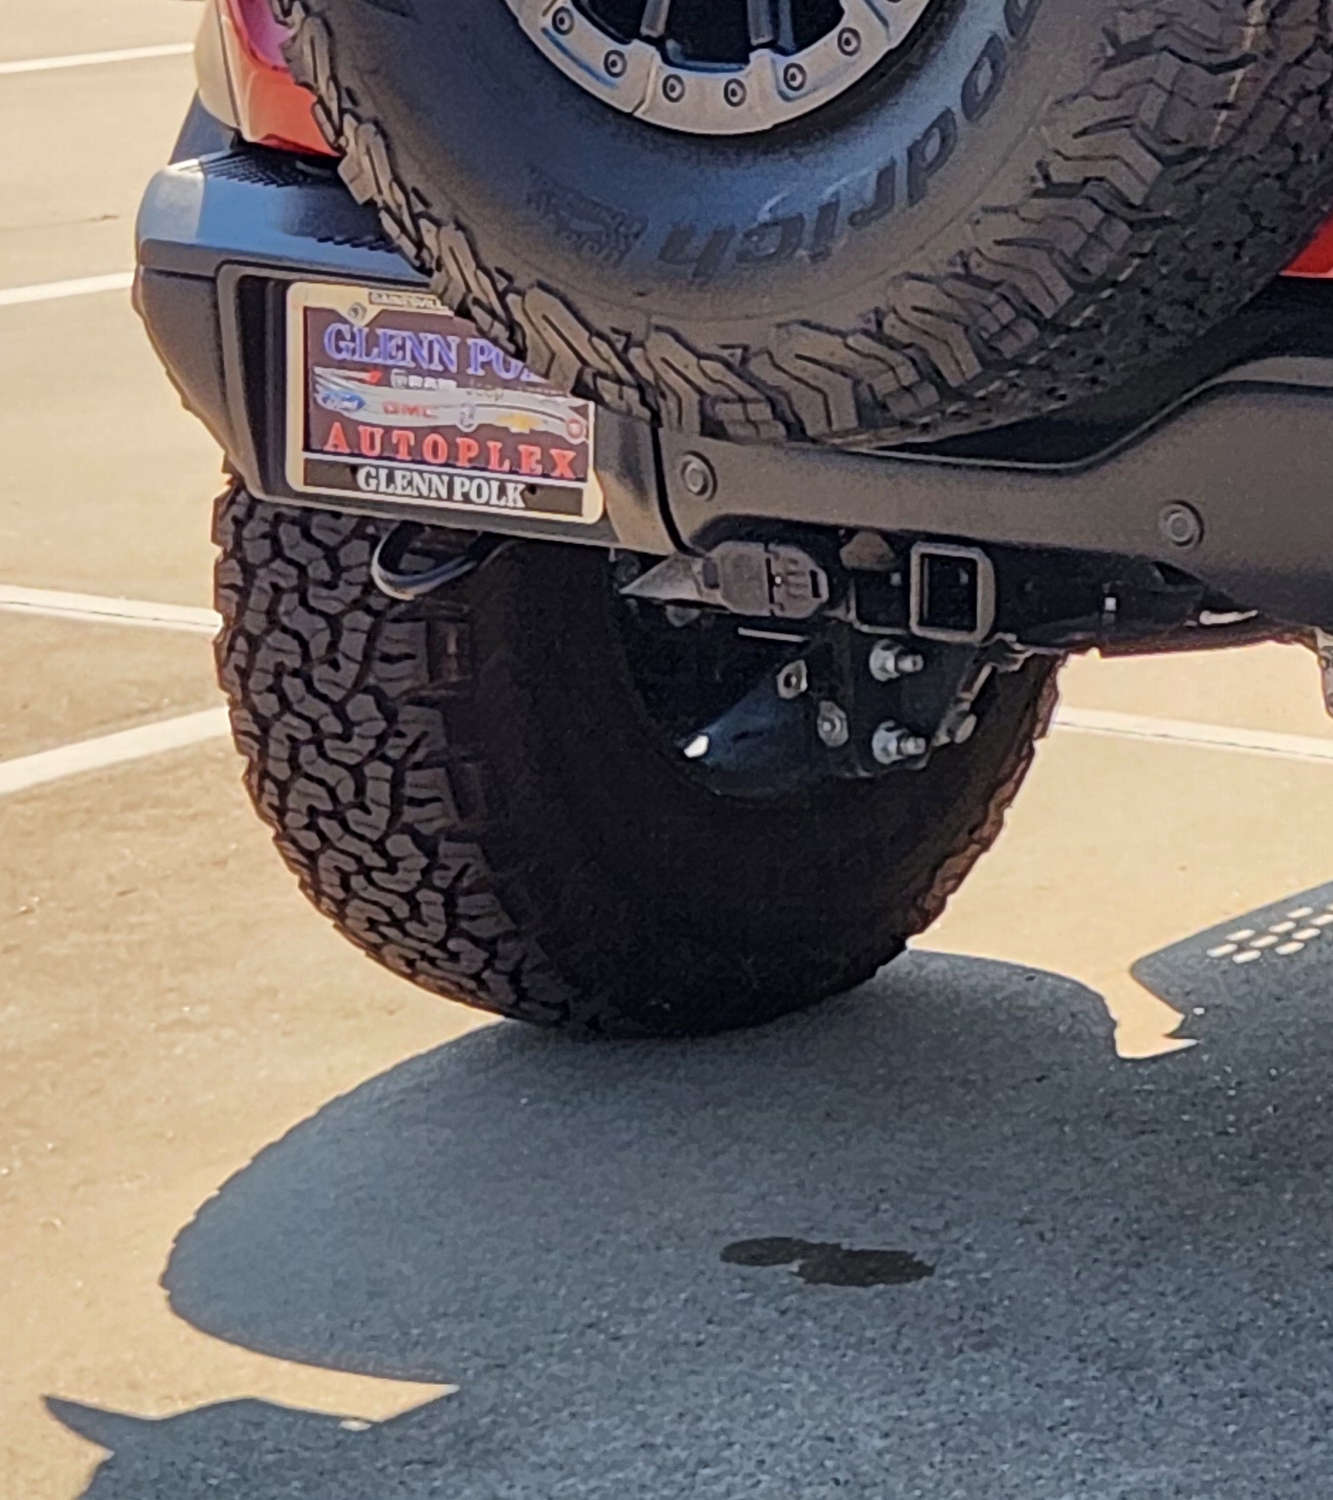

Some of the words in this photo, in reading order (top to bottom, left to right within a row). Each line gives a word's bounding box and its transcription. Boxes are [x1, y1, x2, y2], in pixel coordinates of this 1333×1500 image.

[324, 322, 460, 374] GLENN
[466, 337, 549, 383] PO
[323, 421, 578, 480] AUTOPLEX
[356, 466, 449, 499] GLENN
[452, 479, 526, 509] POLK
